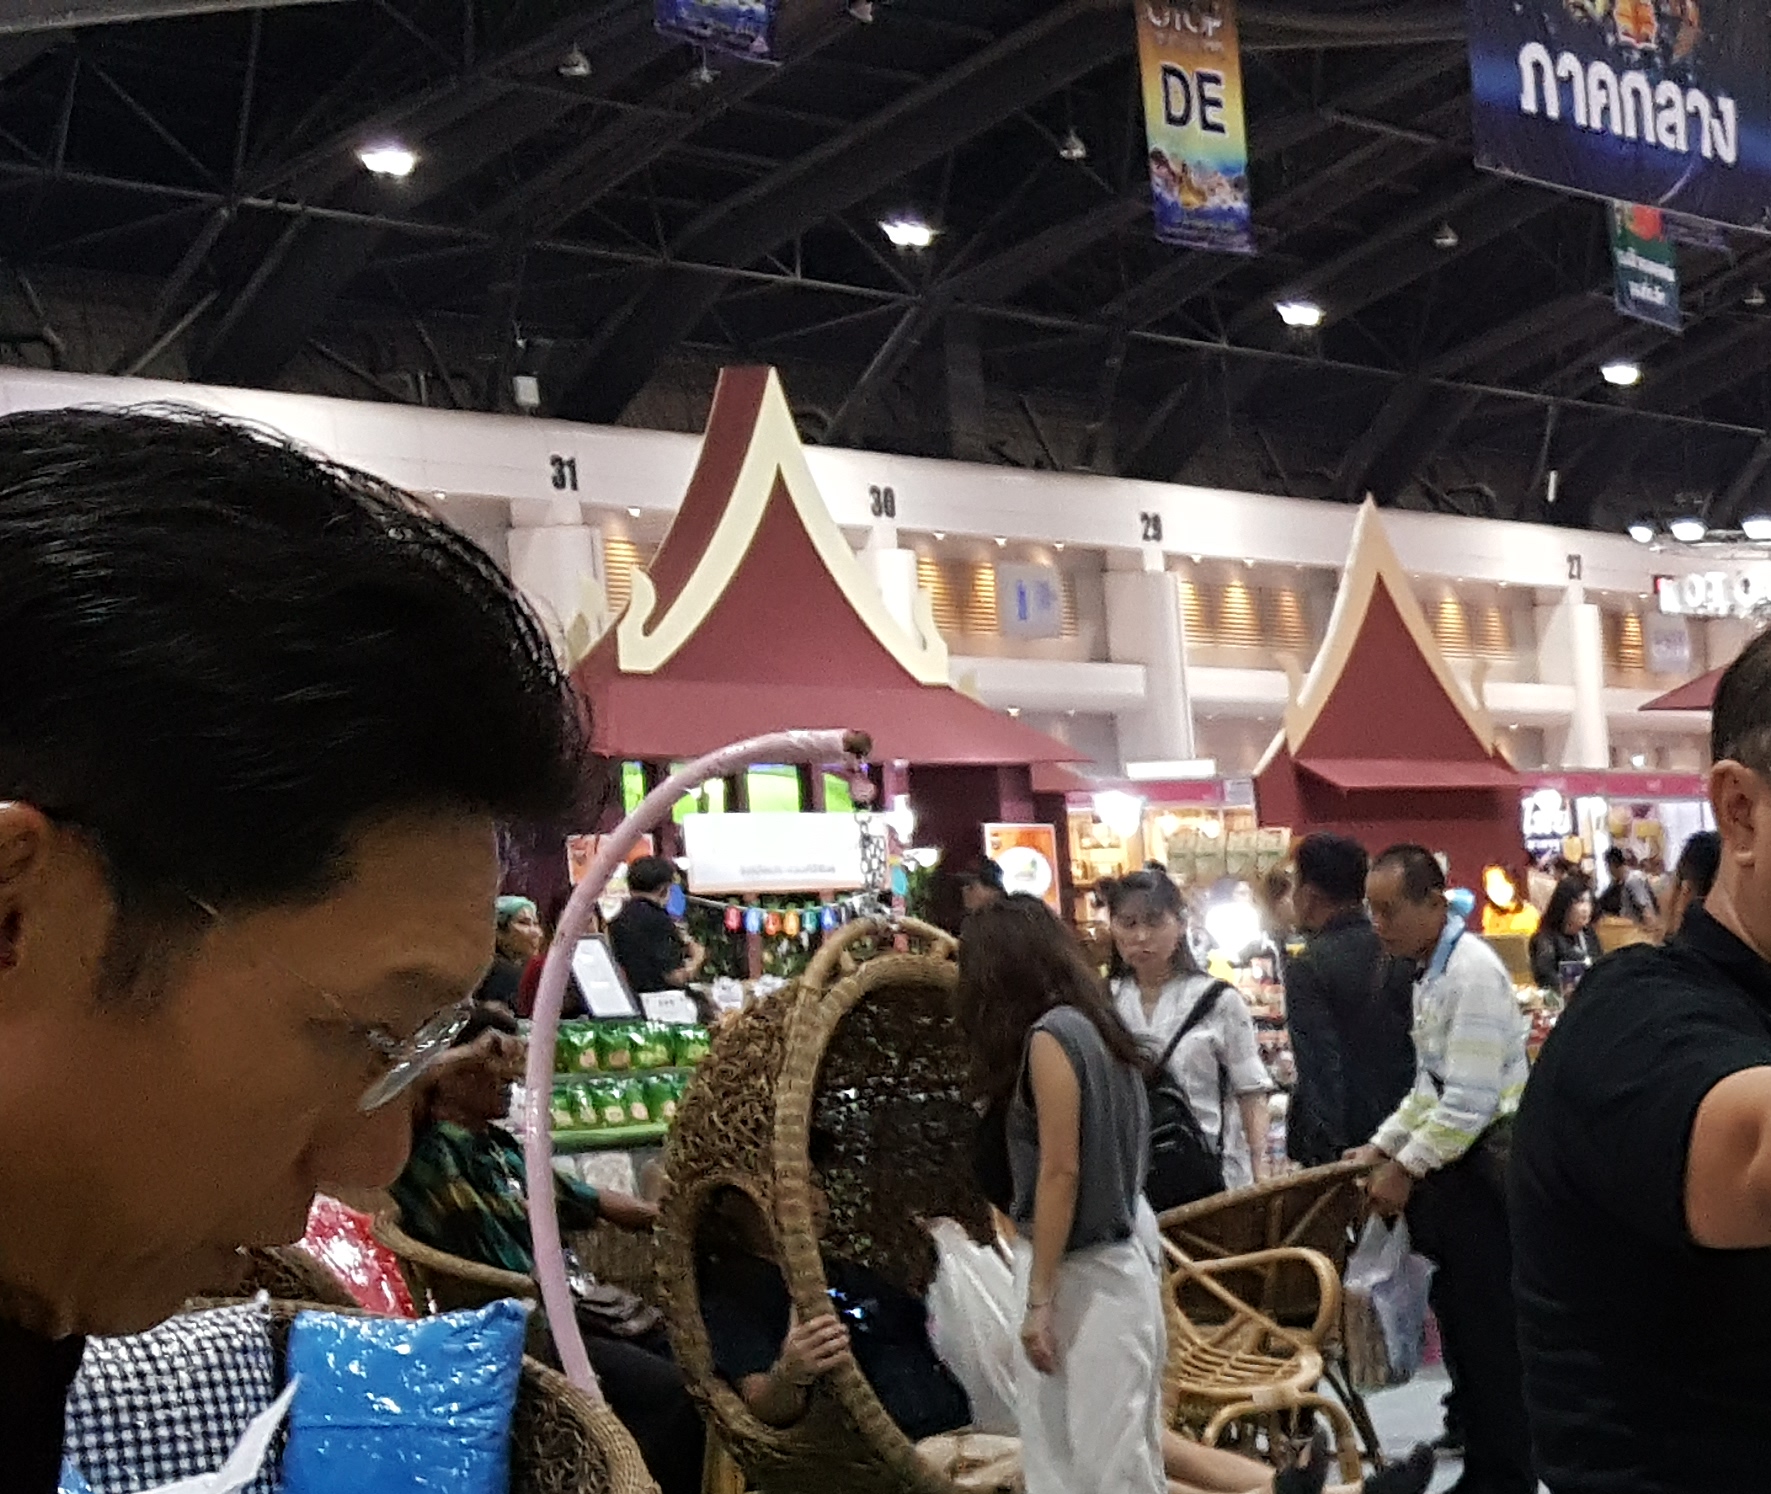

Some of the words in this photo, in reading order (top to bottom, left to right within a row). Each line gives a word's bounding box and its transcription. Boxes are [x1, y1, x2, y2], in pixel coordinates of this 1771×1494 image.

[1160, 61, 1228, 136] DE
[1518, 41, 1738, 167] ภาคกลาง
[550, 455, 578, 492] 31
[868, 484, 897, 518] 30
